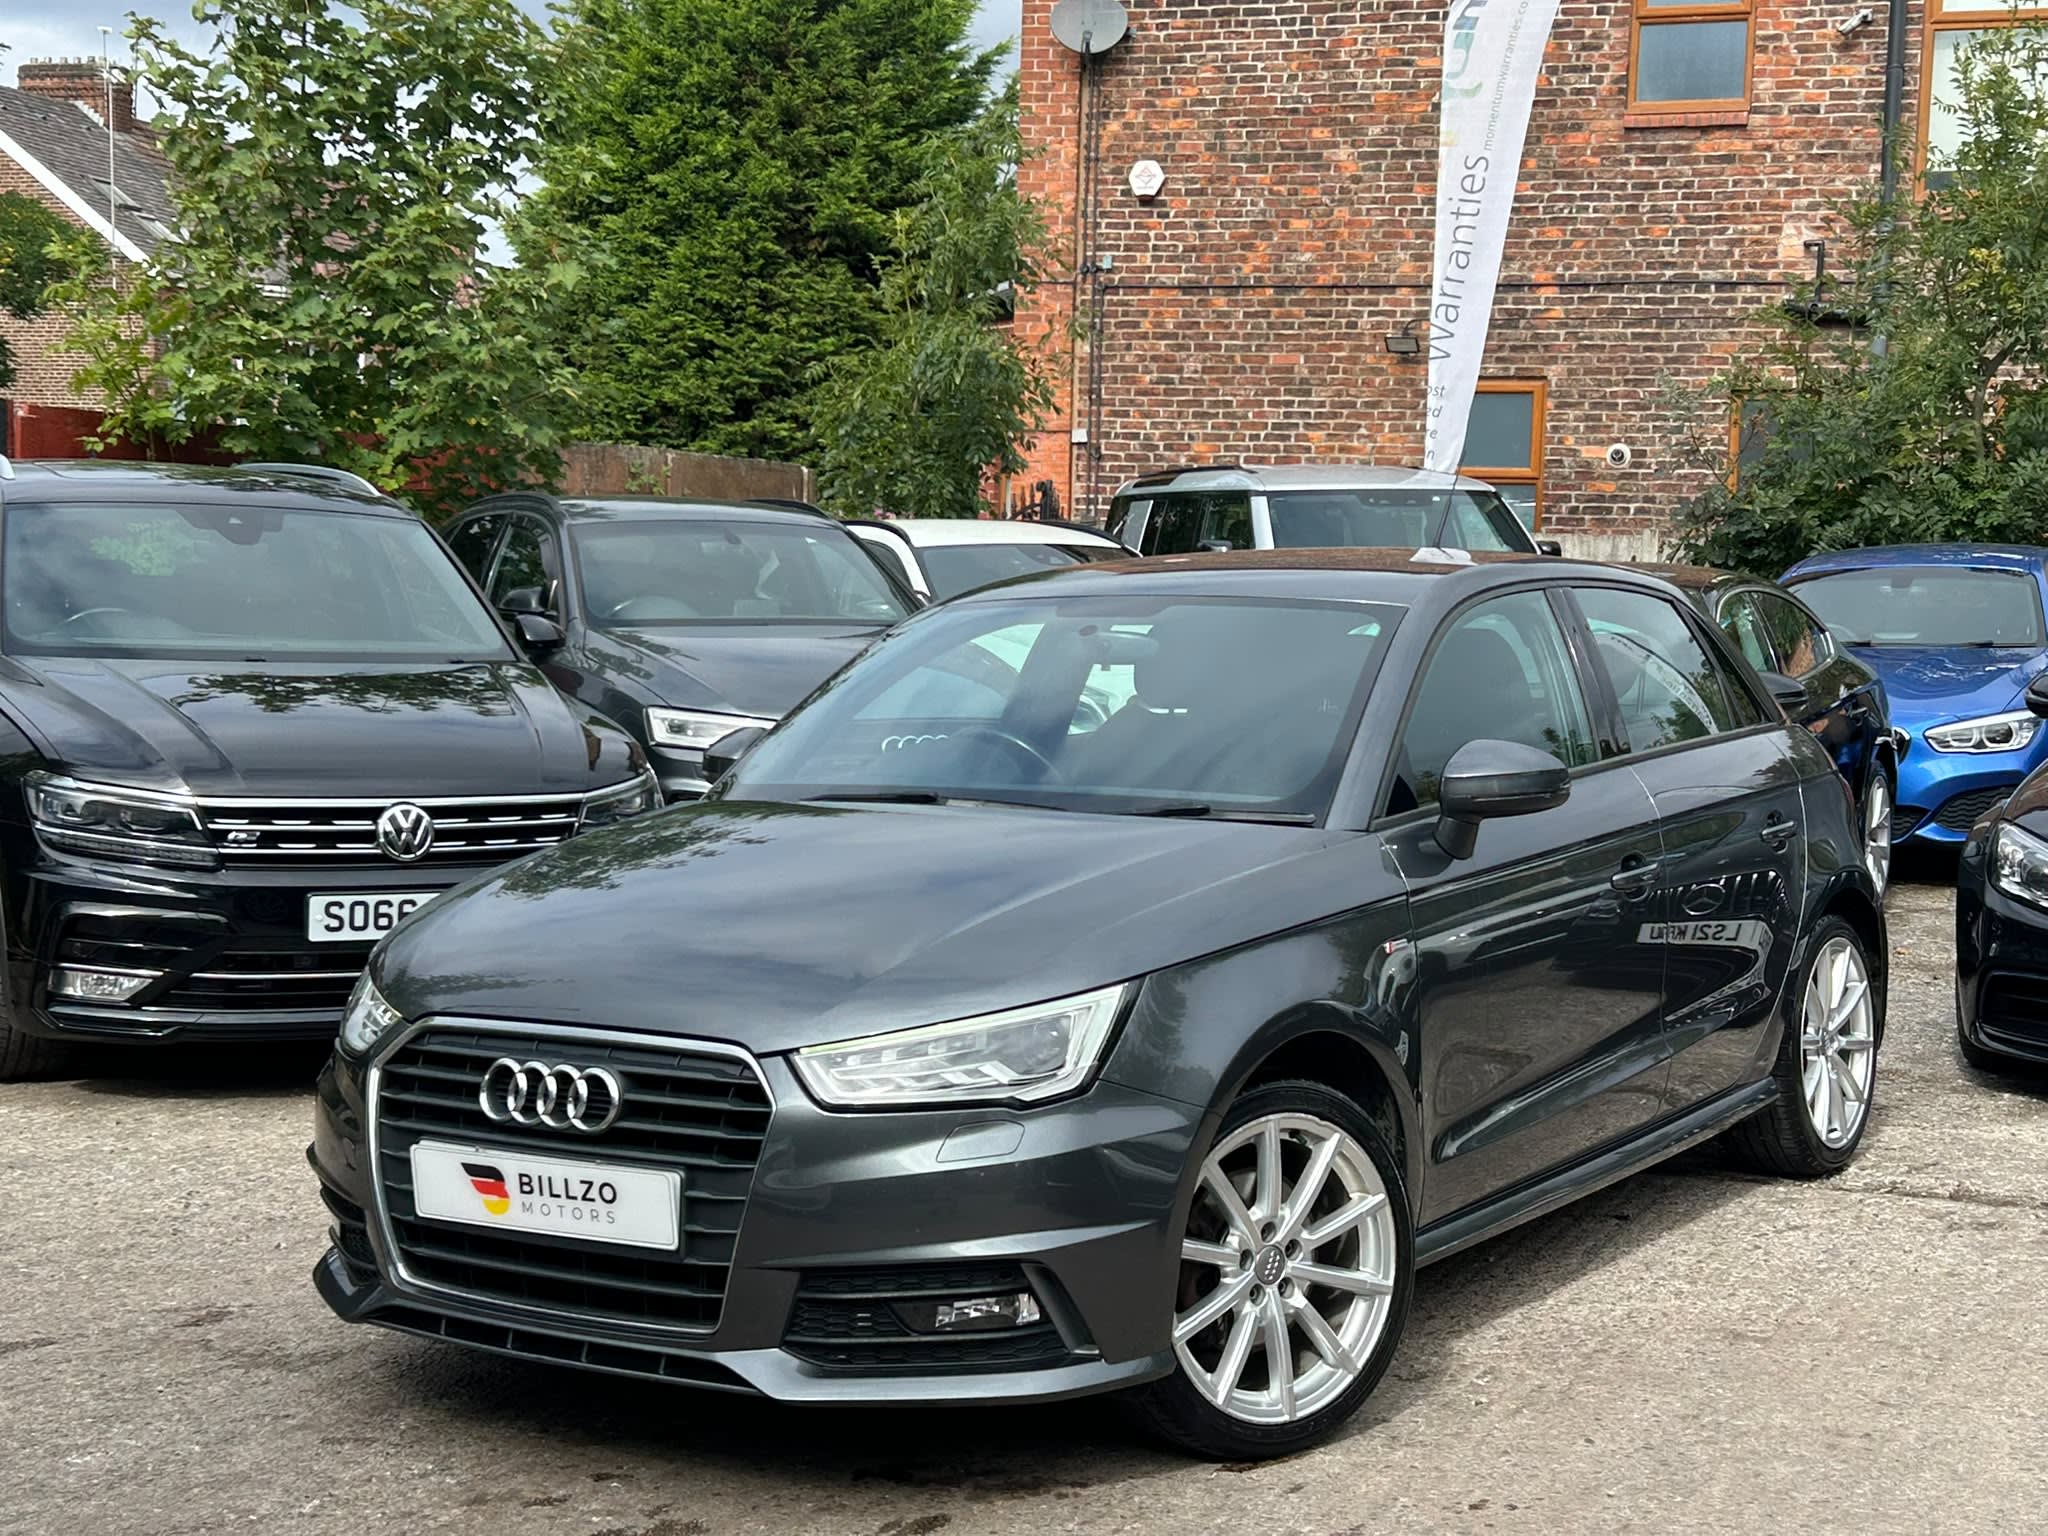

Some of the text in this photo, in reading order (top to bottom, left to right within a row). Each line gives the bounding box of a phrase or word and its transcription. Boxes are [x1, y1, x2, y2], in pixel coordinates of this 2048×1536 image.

[1429, 154, 1489, 361] Warranties
[518, 1172, 618, 1205] BILLZO
[521, 1201, 616, 1224] MOTORS
